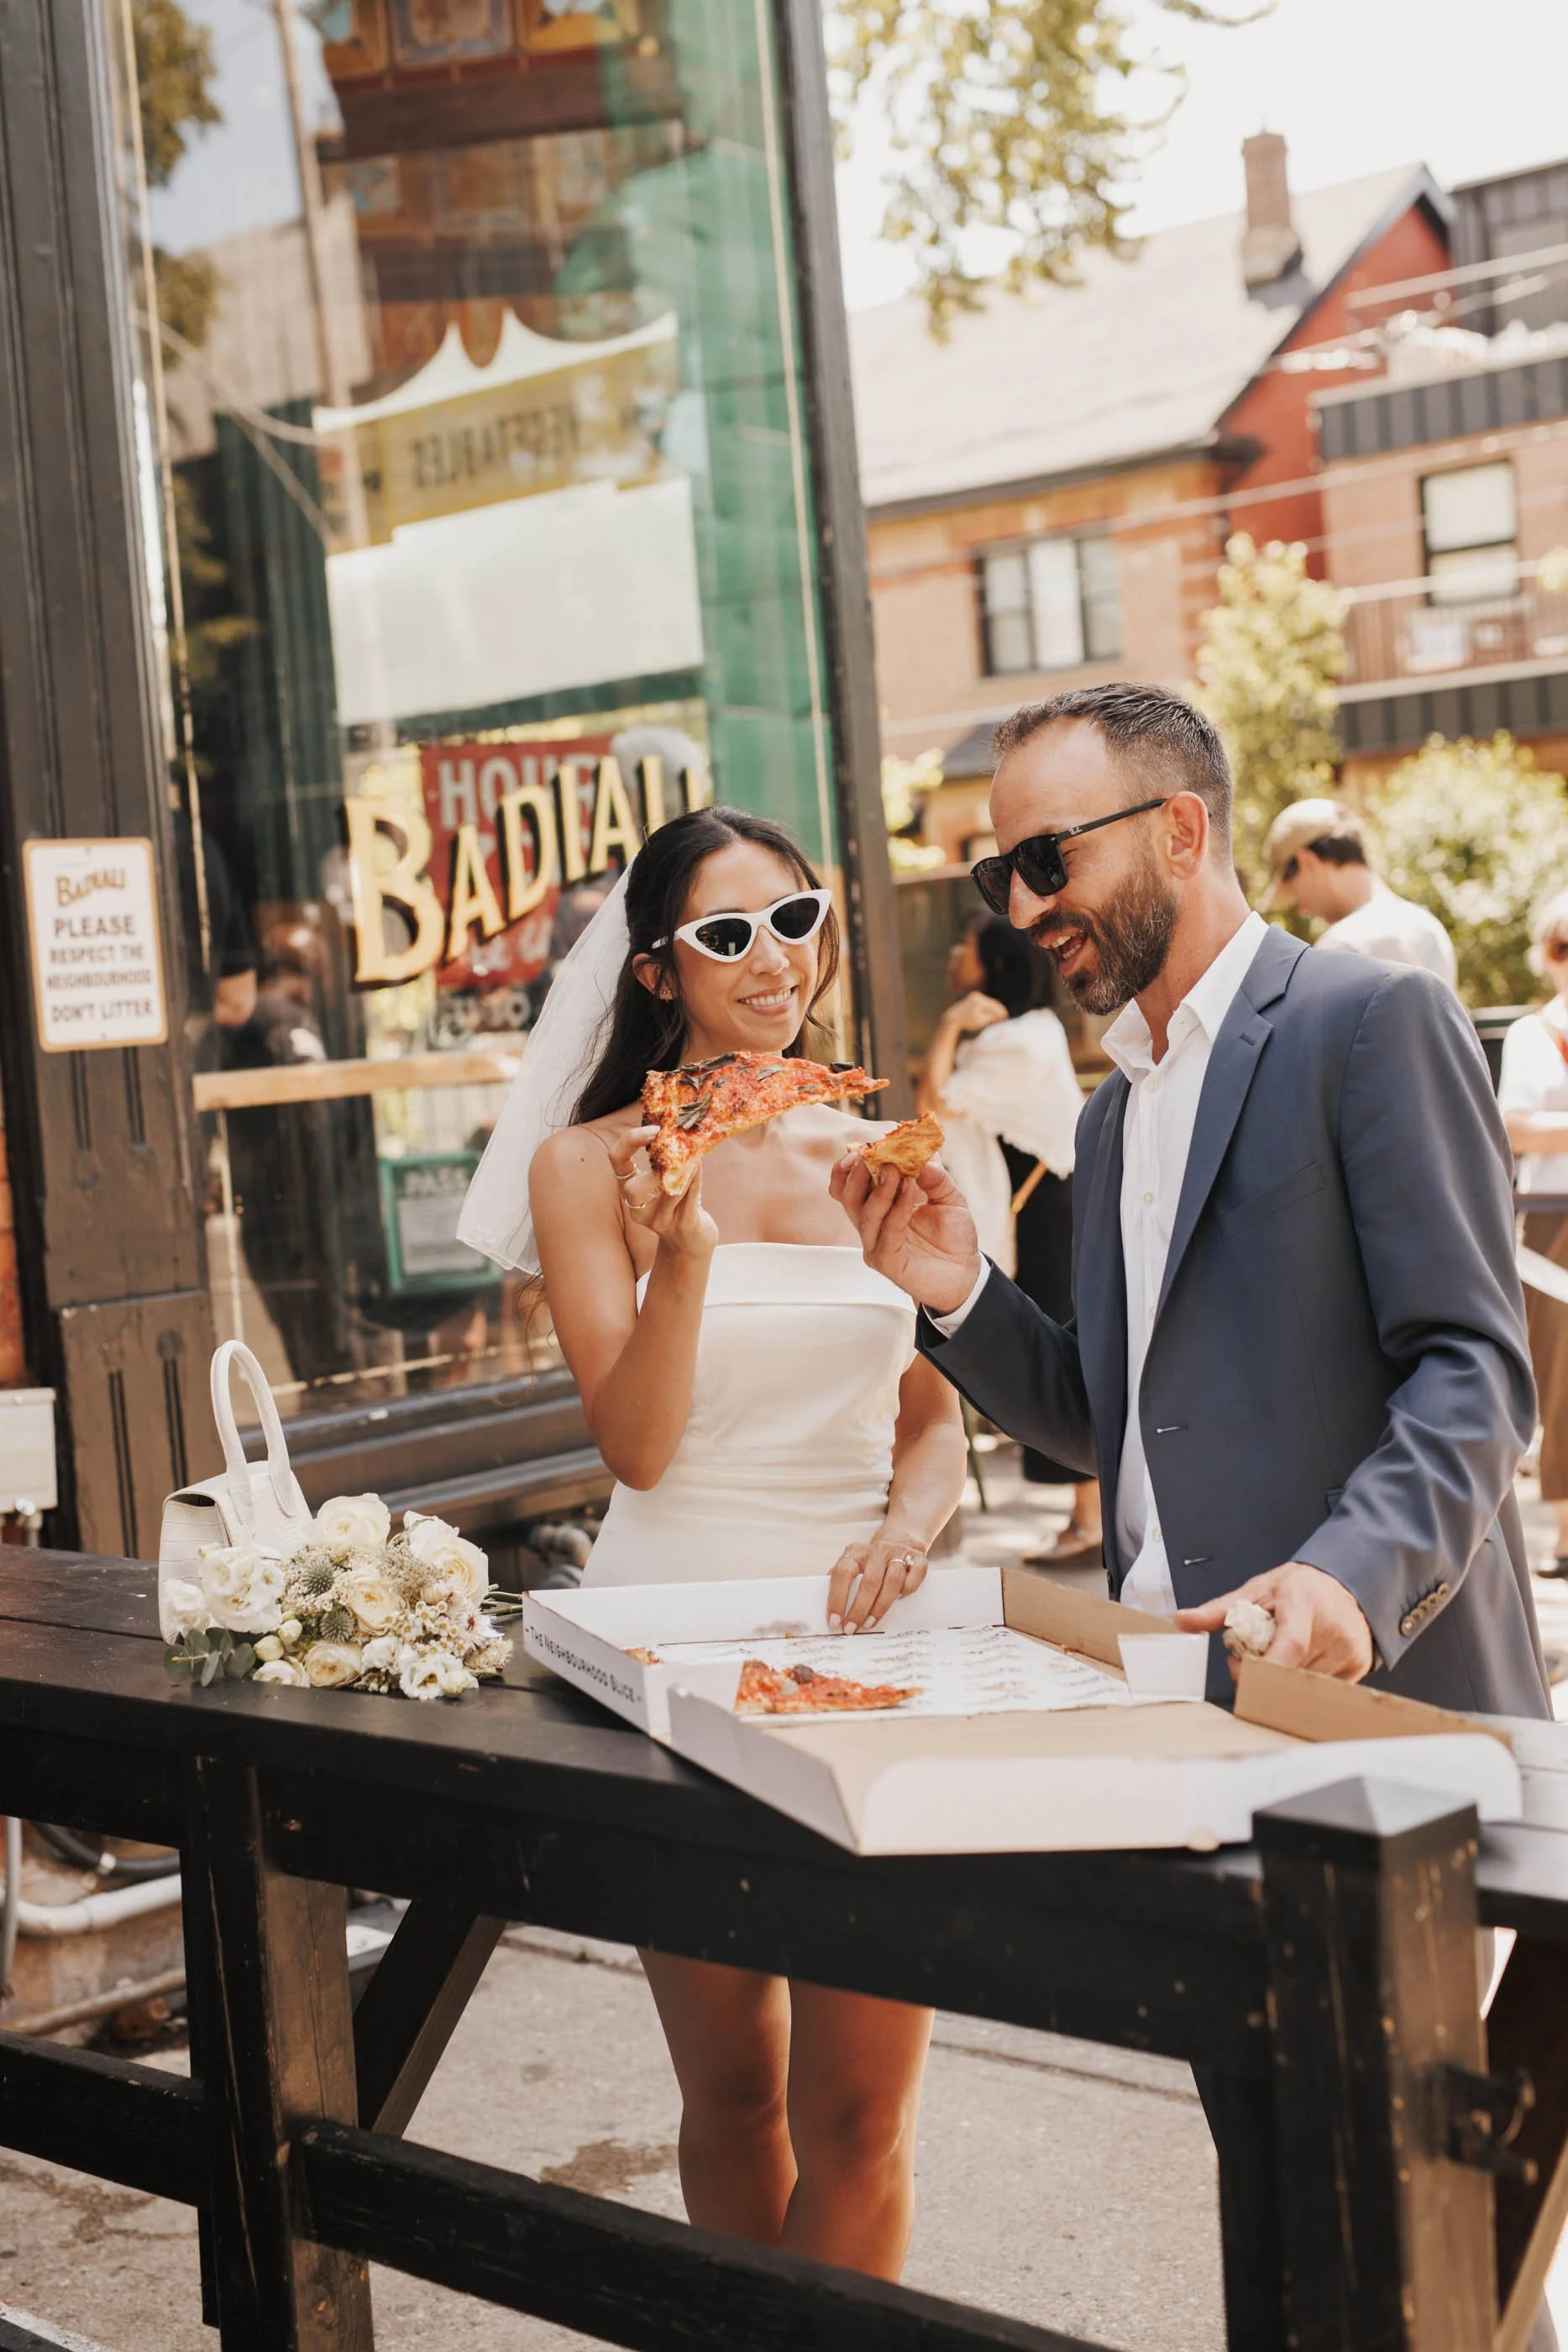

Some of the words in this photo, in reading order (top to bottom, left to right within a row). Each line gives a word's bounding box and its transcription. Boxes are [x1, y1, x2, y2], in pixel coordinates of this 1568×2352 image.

[53, 914, 136, 937] PLEASE
[50, 947, 115, 964] RESPECT
[122, 944, 144, 960] THE
[47, 969, 152, 990] NEIGHBOURHOOD
[51, 1003, 96, 1022] DON'T
[101, 998, 153, 1019] LITTER
[530, 1625, 544, 1647] THE
[544, 1633, 608, 1687] NEIGHBOURHOOD
